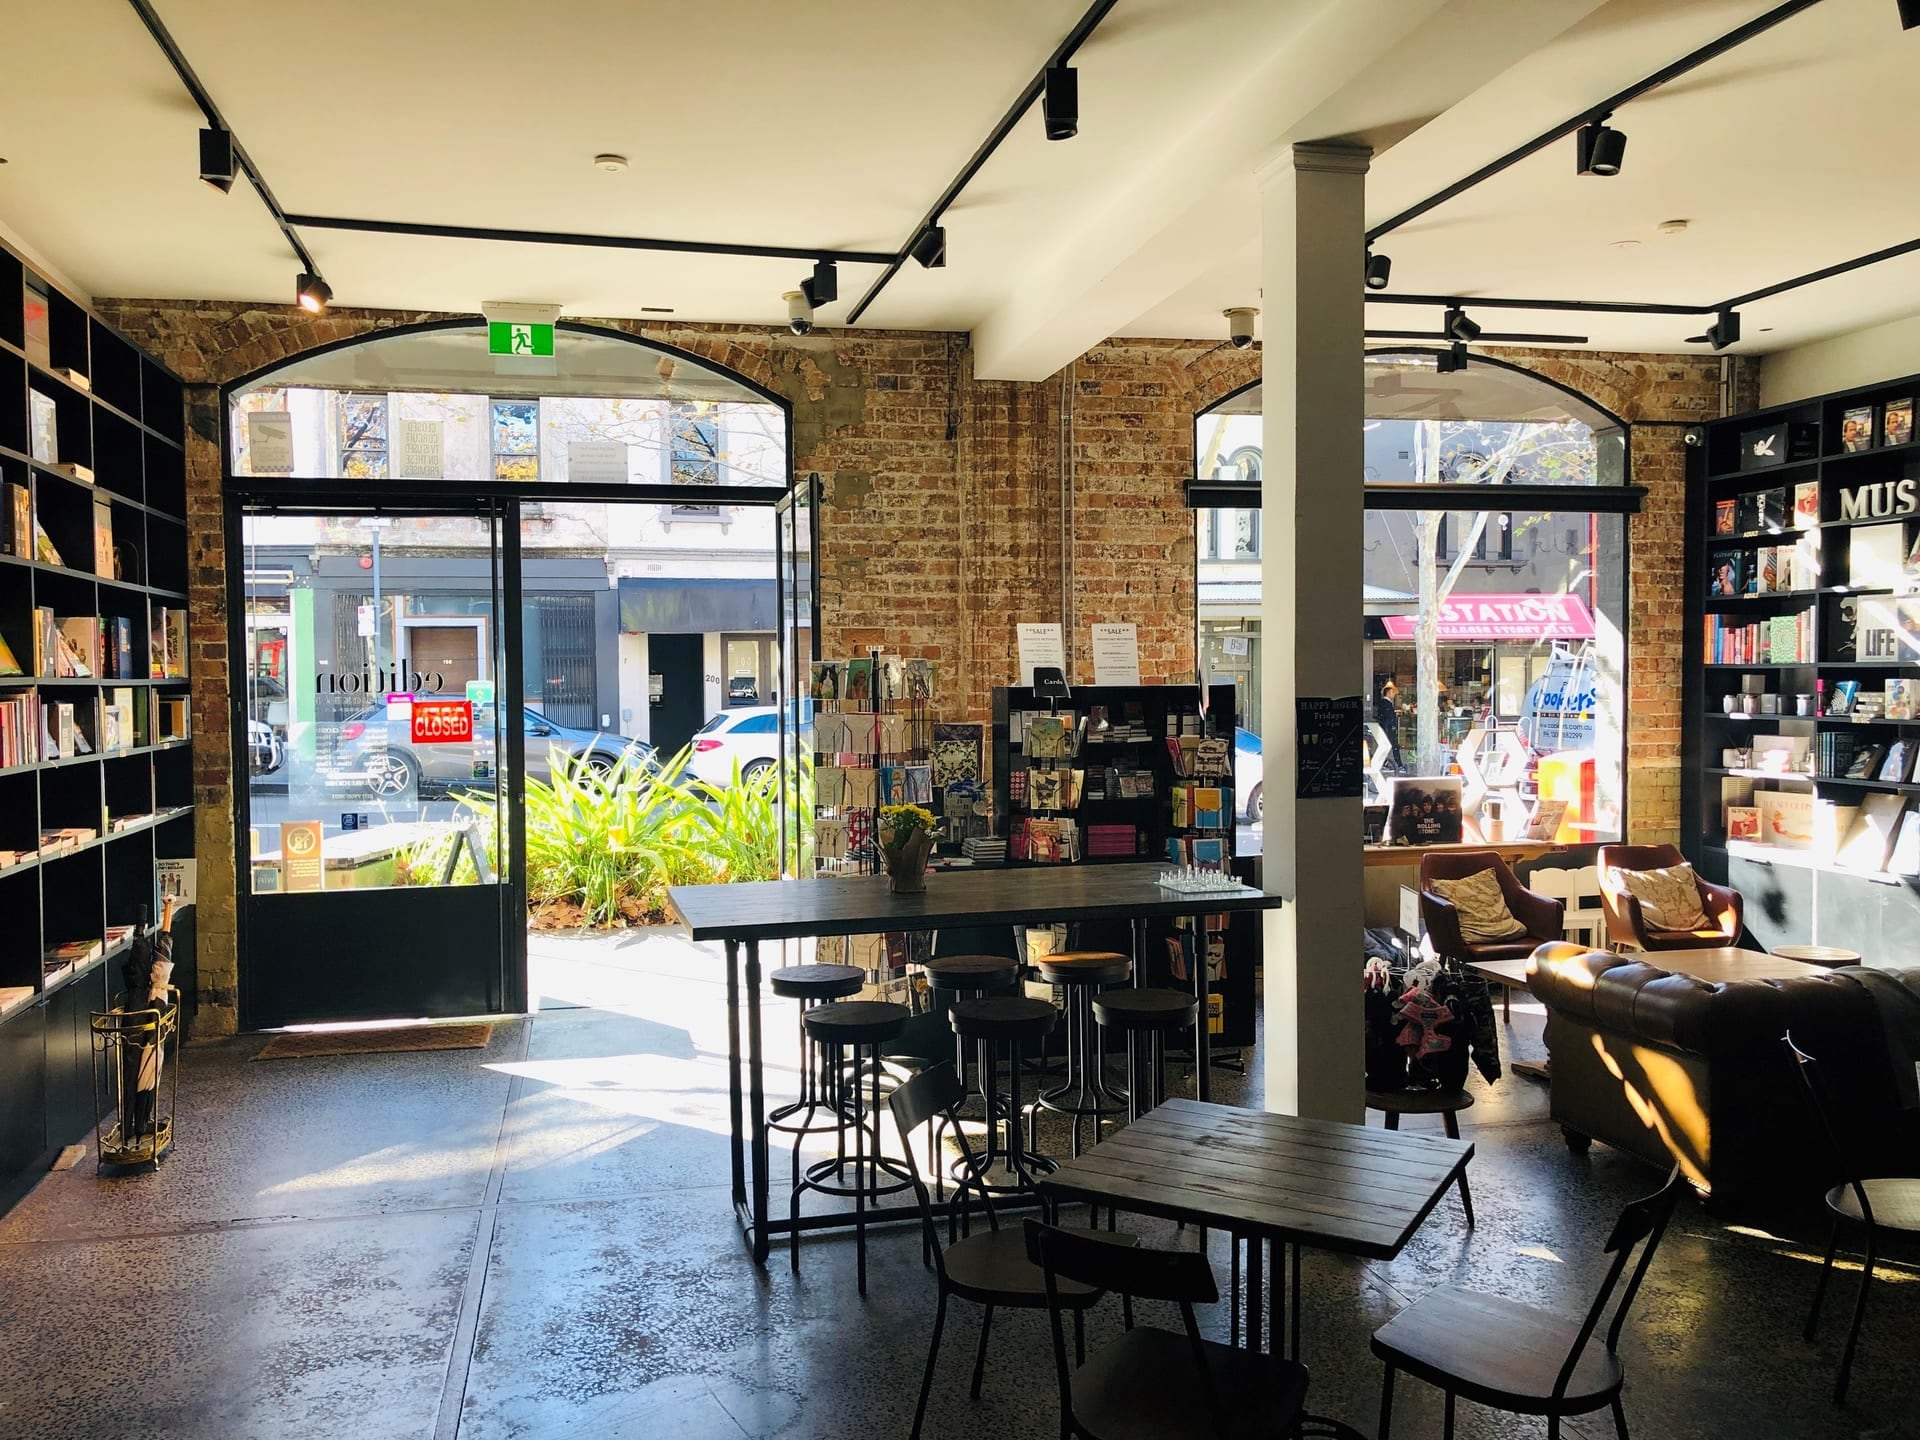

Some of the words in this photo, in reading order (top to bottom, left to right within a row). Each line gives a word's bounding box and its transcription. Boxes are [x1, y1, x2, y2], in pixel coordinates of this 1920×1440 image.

[1865, 628, 1896, 656] LIFE
[705, 674, 720, 684] 200
[1300, 701, 1330, 710] HAPPY
[415, 716, 469, 737] CLOSED
